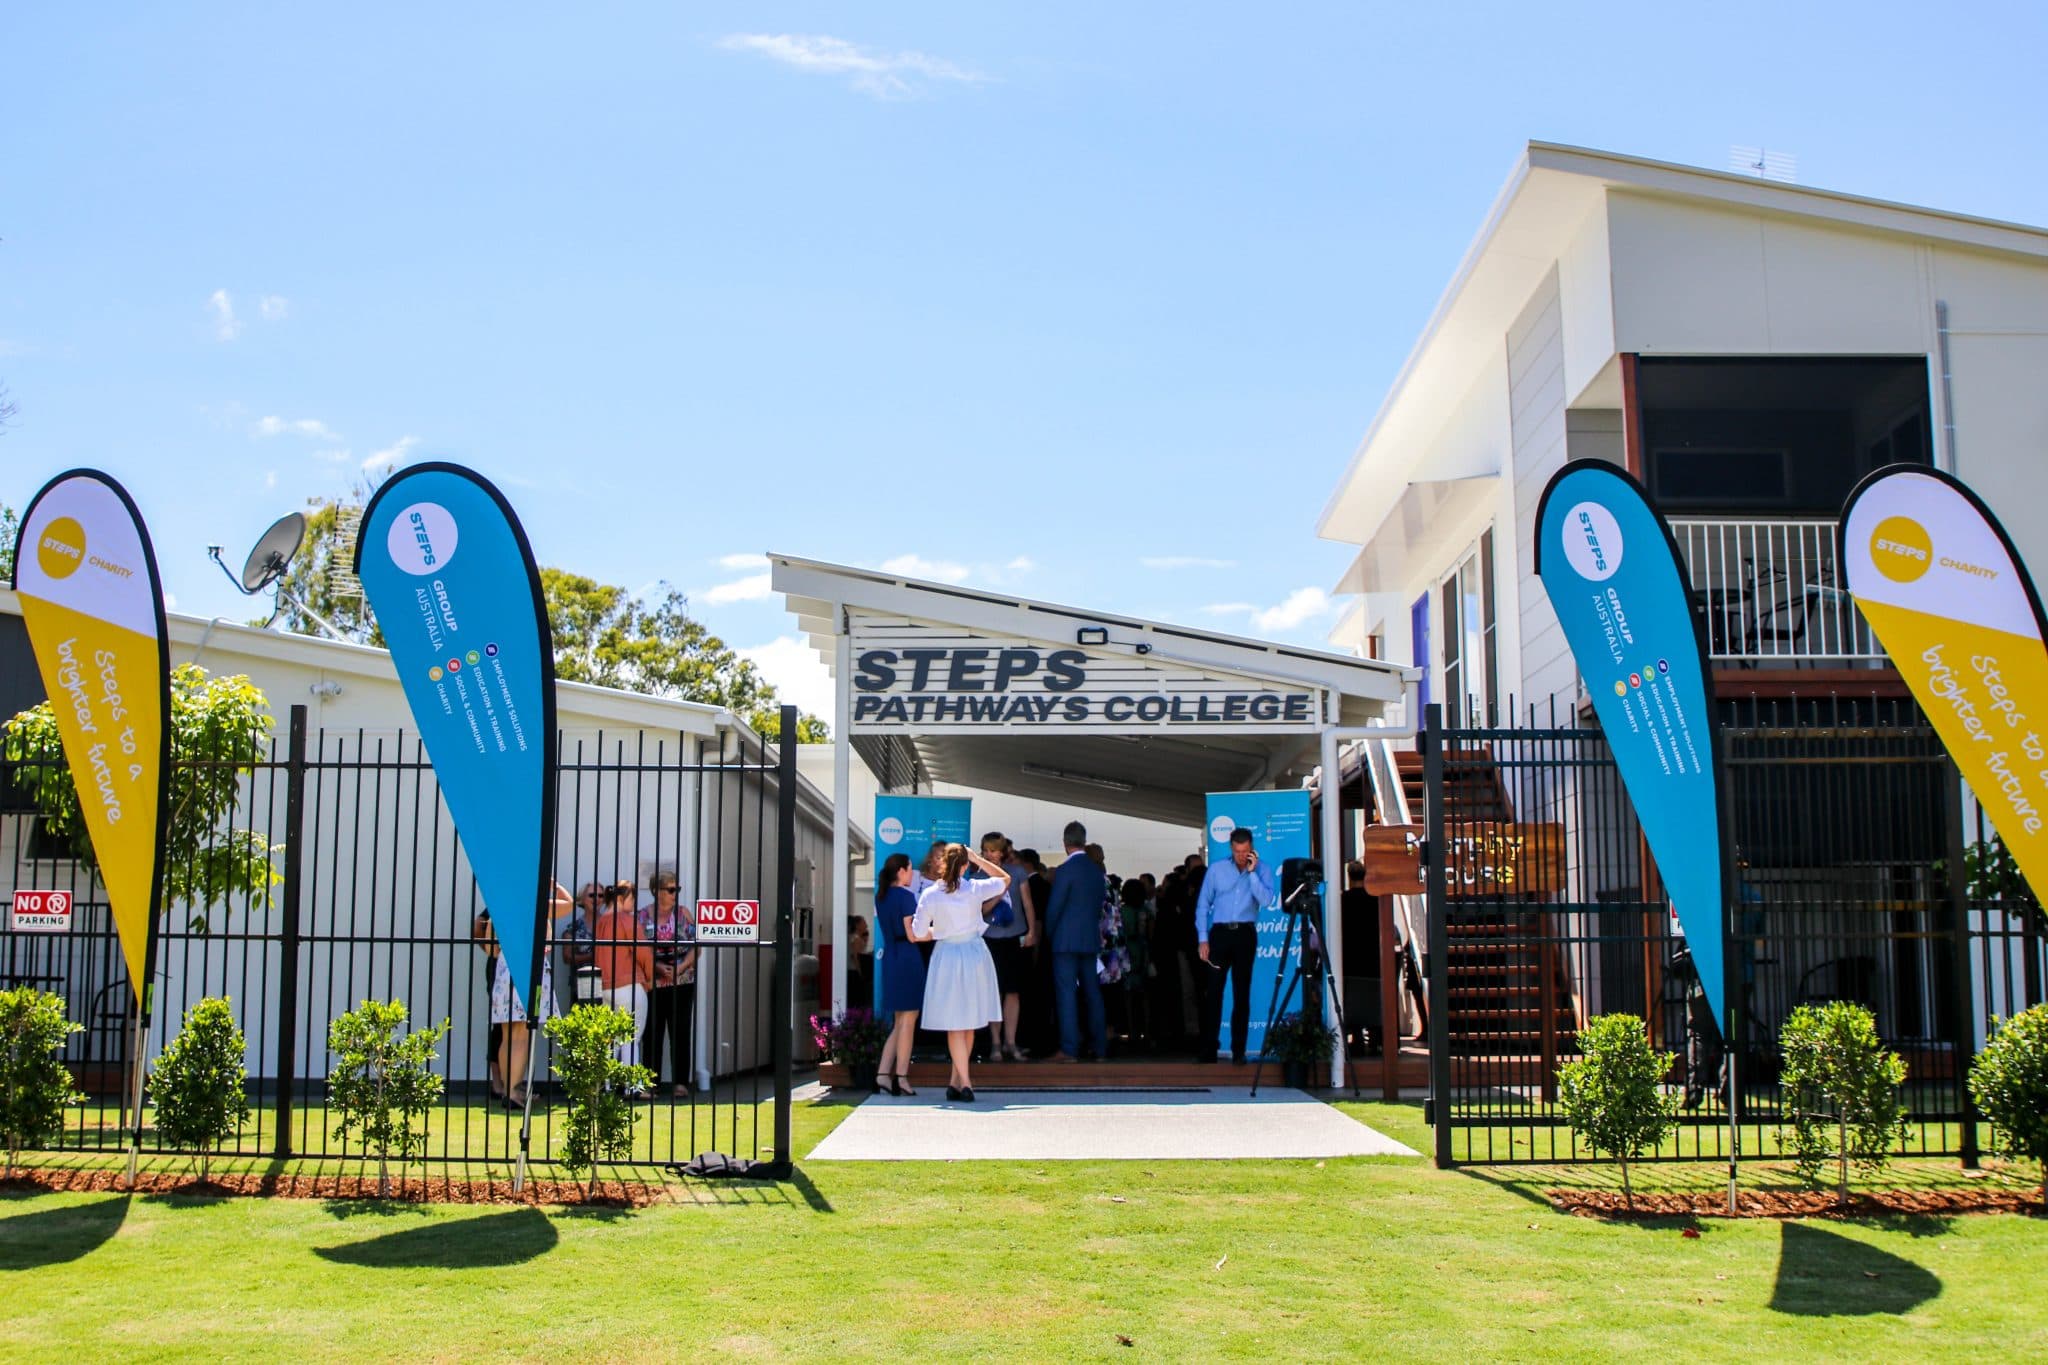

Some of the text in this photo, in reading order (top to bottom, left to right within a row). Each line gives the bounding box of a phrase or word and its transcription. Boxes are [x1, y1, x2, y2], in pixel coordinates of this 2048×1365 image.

[43, 537, 80, 559] STEPS
[410, 512, 436, 566] STEPS
[1579, 511, 1606, 572] STEPS
[1876, 538, 1926, 560] STEPS
[89, 556, 135, 579] CHARITY
[1940, 557, 1998, 579] CHARITY
[415, 587, 444, 652] AUSTRALIA
[433, 579, 458, 632] GROUP
[1592, 594, 1625, 665] AUSTRALIA
[1607, 587, 1633, 645] GROUP
[436, 682, 453, 715] CHARITY
[854, 650, 1088, 692] STEPS
[57, 637, 122, 825] brighter future
[95, 649, 143, 783] Steps to a
[455, 674, 468, 702] SOCIAL
[466, 709, 486, 754] COMMUNITY
[473, 666, 507, 752] EDUCATION & TRAINING
[491, 658, 528, 752] EMPLOYMENT SOLUTIONS
[854, 694, 1309, 722] PATHWAYS COLLEGE
[1622, 698, 1640, 734] CHARITY
[1636, 690, 1651, 720] SOCIAL
[1650, 728, 1672, 776] COMMUNITY
[1650, 683, 1671, 728] EDUCATION
[1668, 735, 1686, 774] TRAINING
[1664, 675, 1702, 774] EMPLOYMENT SOLUTIONS
[1971, 655, 2045, 761] Steps to
[1922, 644, 2043, 836] brighter future
[16, 895, 41, 911] NO
[18, 916, 64, 925] PARKING
[701, 905, 726, 921] NO
[702, 926, 751, 935] PARKING
